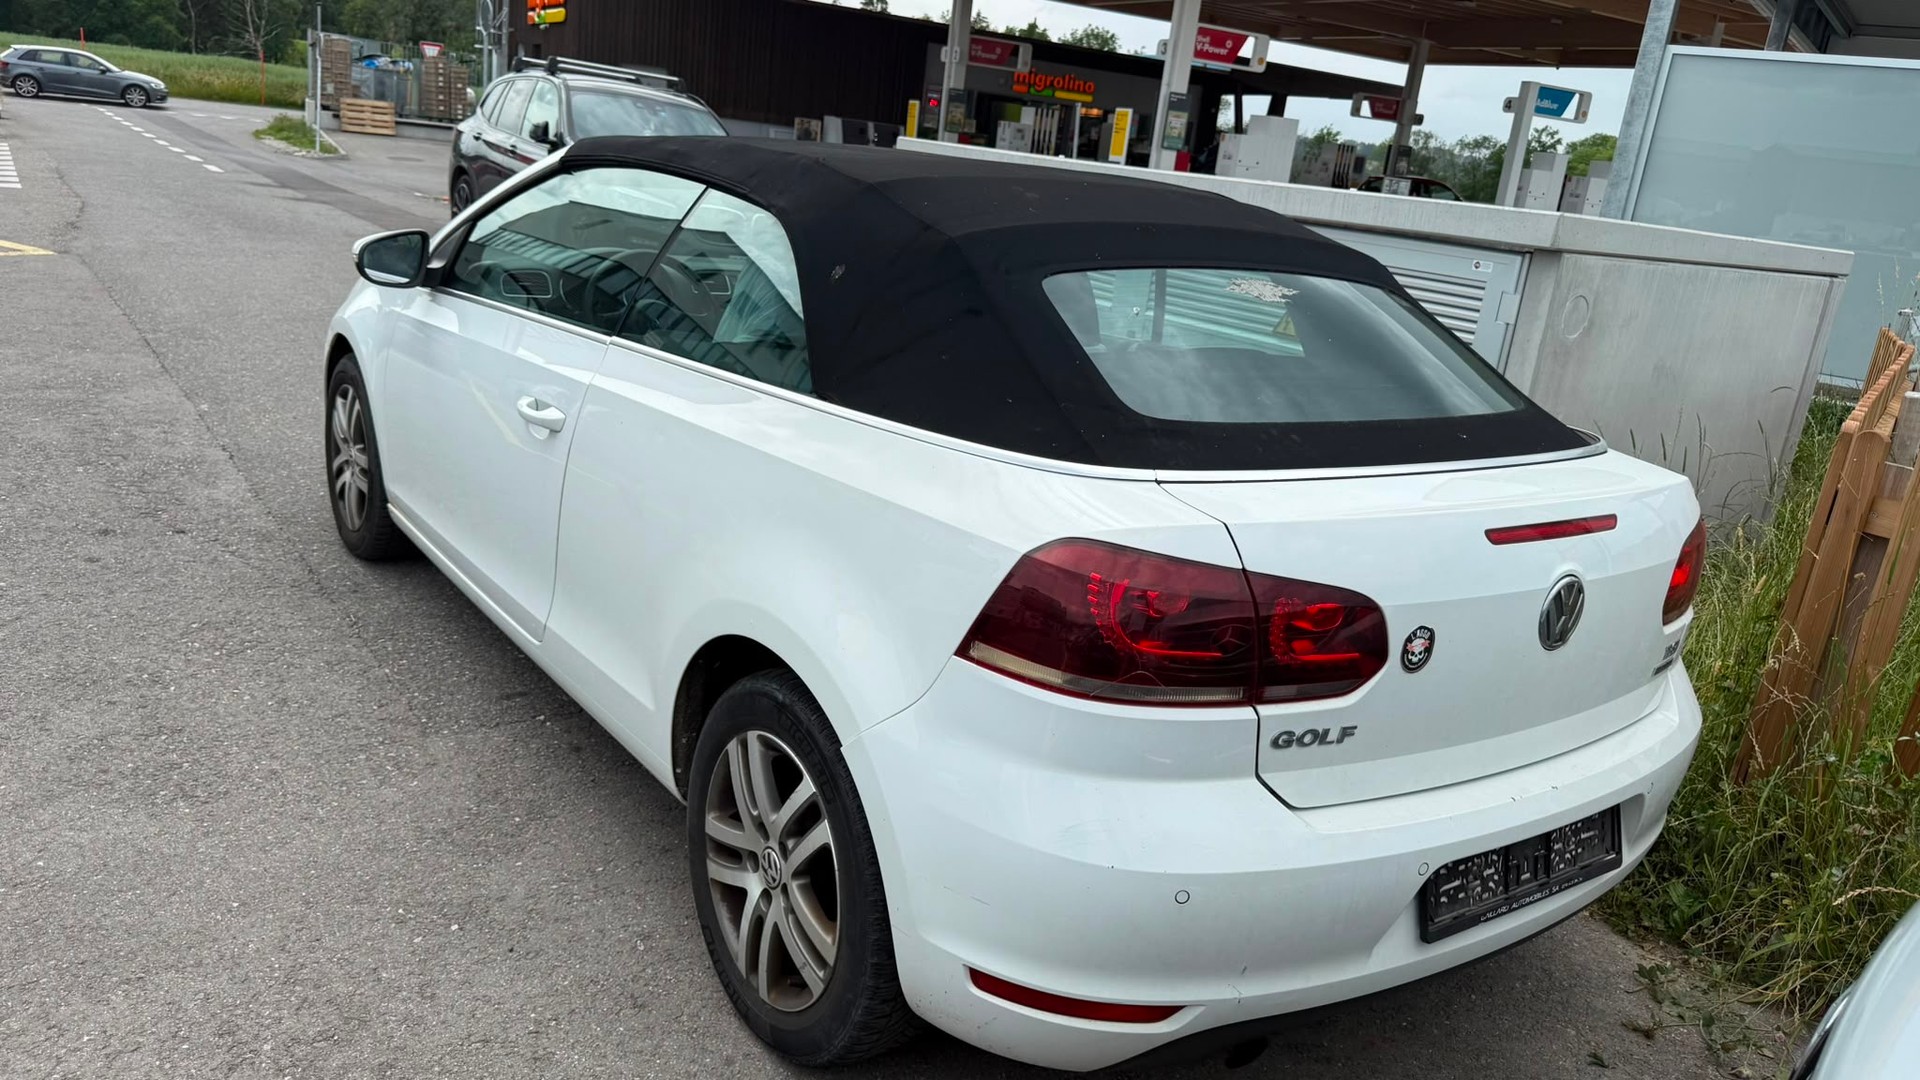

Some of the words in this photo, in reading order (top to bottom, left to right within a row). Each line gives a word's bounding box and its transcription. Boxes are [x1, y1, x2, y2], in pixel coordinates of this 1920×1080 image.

[1160, 42, 1168, 55] 3
[1195, 41, 1229, 56] V-Power
[1013, 67, 1096, 94] migrolino
[1504, 99, 1512, 111] 4
[1269, 725, 1358, 750] GOLF
